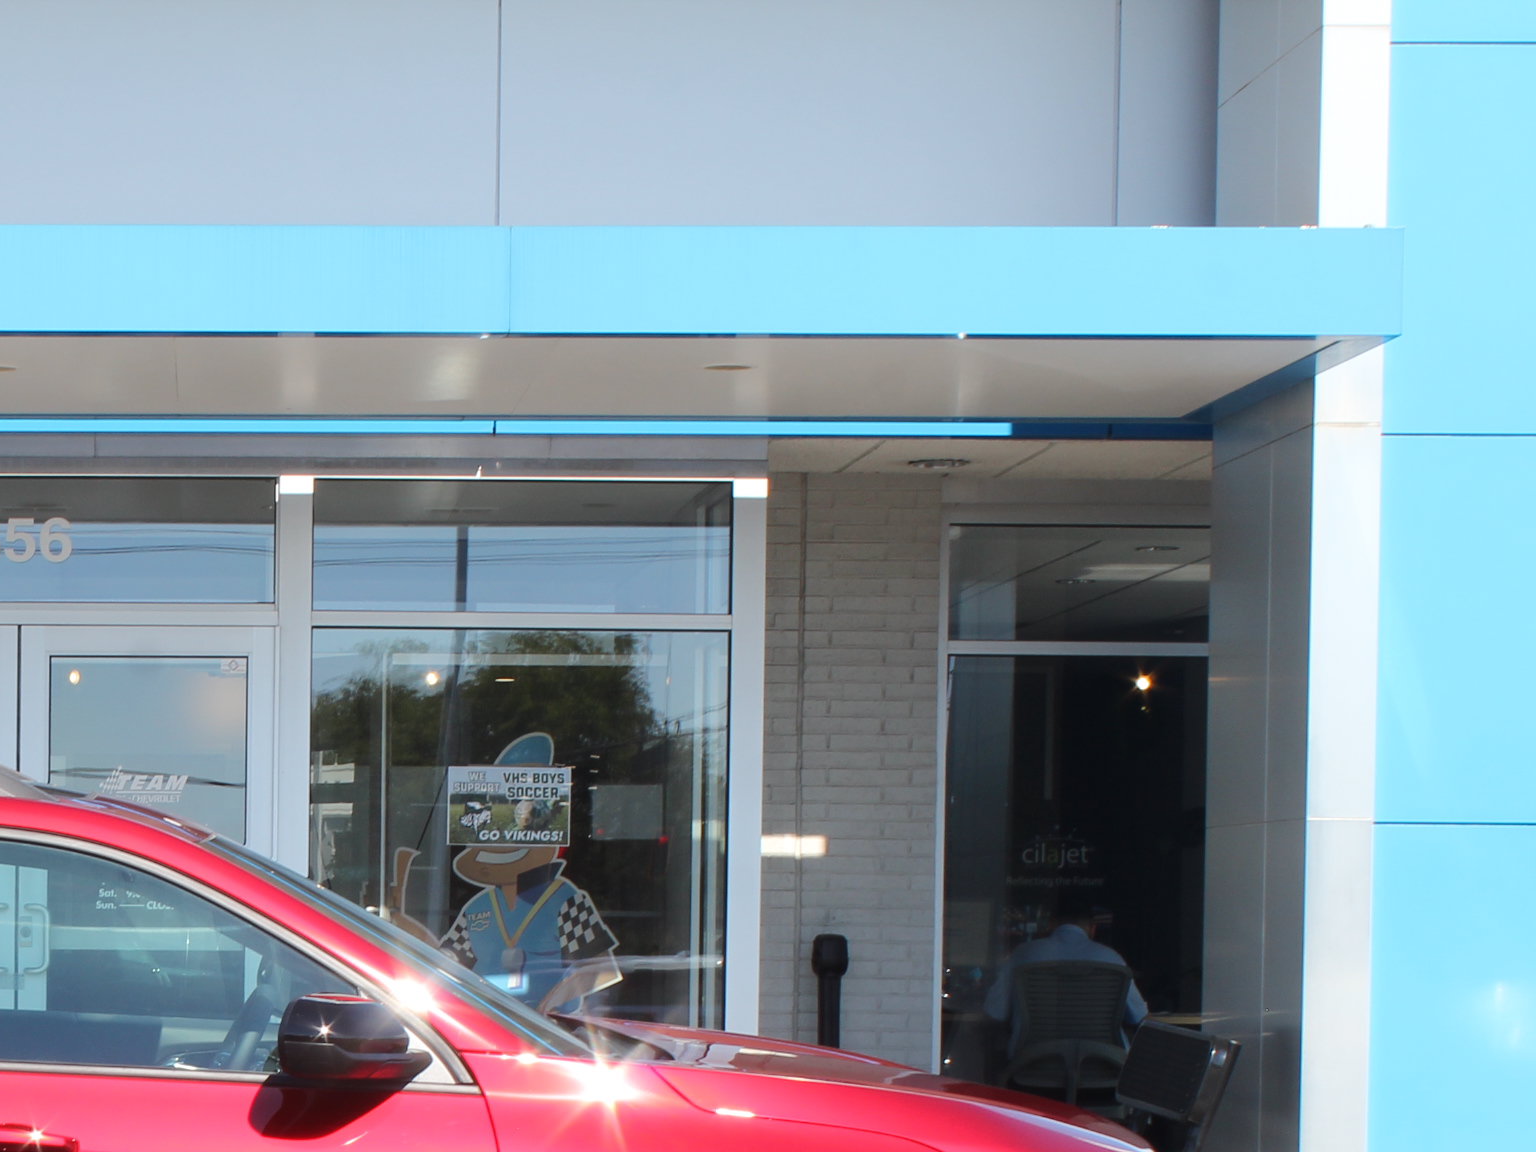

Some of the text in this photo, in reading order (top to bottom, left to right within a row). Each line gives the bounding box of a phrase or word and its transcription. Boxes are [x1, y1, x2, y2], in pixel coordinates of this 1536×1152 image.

[116, 774, 189, 790] TEAM
[468, 771, 486, 782] WE
[503, 772, 565, 784] VHS BOYS
[454, 782, 500, 792] SUPPORT
[507, 787, 558, 798] SOCCER
[478, 830, 564, 841] GO VIKINGS!
[1021, 843, 1089, 868] cilajet
[95, 900, 175, 910] Sun. CLO
[468, 911, 492, 921] TEAM
